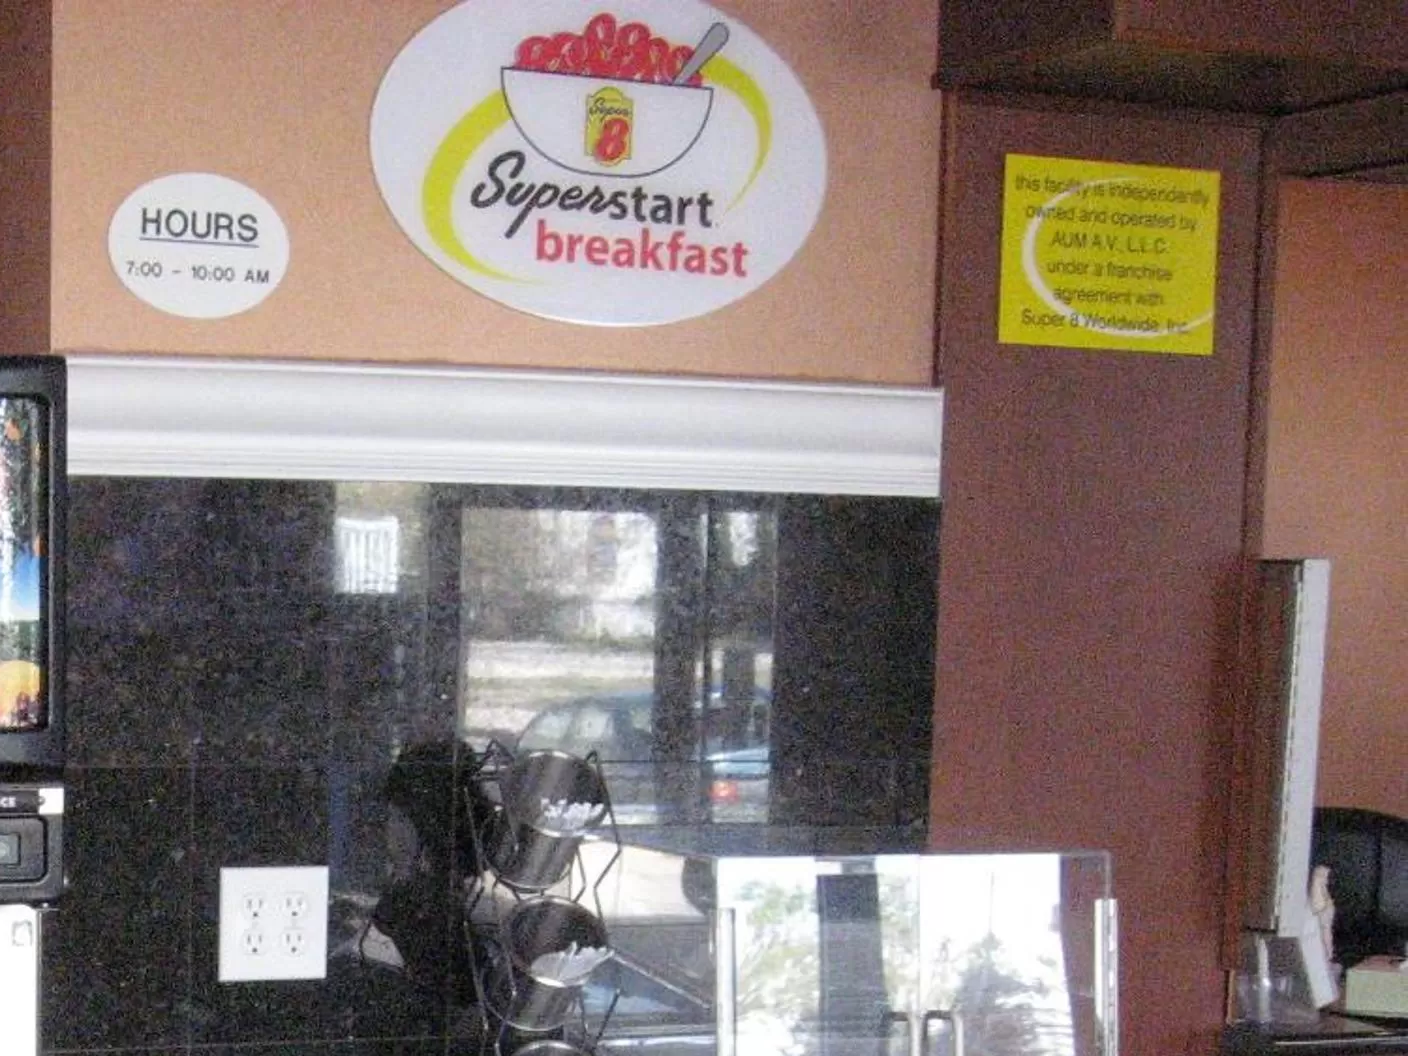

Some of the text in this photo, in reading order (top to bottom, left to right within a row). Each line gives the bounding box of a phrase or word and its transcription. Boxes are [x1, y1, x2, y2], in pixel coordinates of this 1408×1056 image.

[595, 118, 630, 164] 8
[470, 151, 714, 239] Superstart
[1016, 174, 1041, 192] this
[1092, 182, 1106, 197] is
[141, 207, 259, 242] HOURS
[1025, 204, 1198, 232] owned and operated by
[536, 219, 749, 278] breakfast
[126, 260, 163, 278] 7:00
[191, 265, 235, 282] 10:00
[244, 269, 270, 283] AM
[1047, 259, 1089, 275] under
[1107, 262, 1173, 281] franchise
[1054, 287, 1131, 304] agreement
[1022, 309, 1065, 330] Super
[1070, 313, 1080, 327] 8
